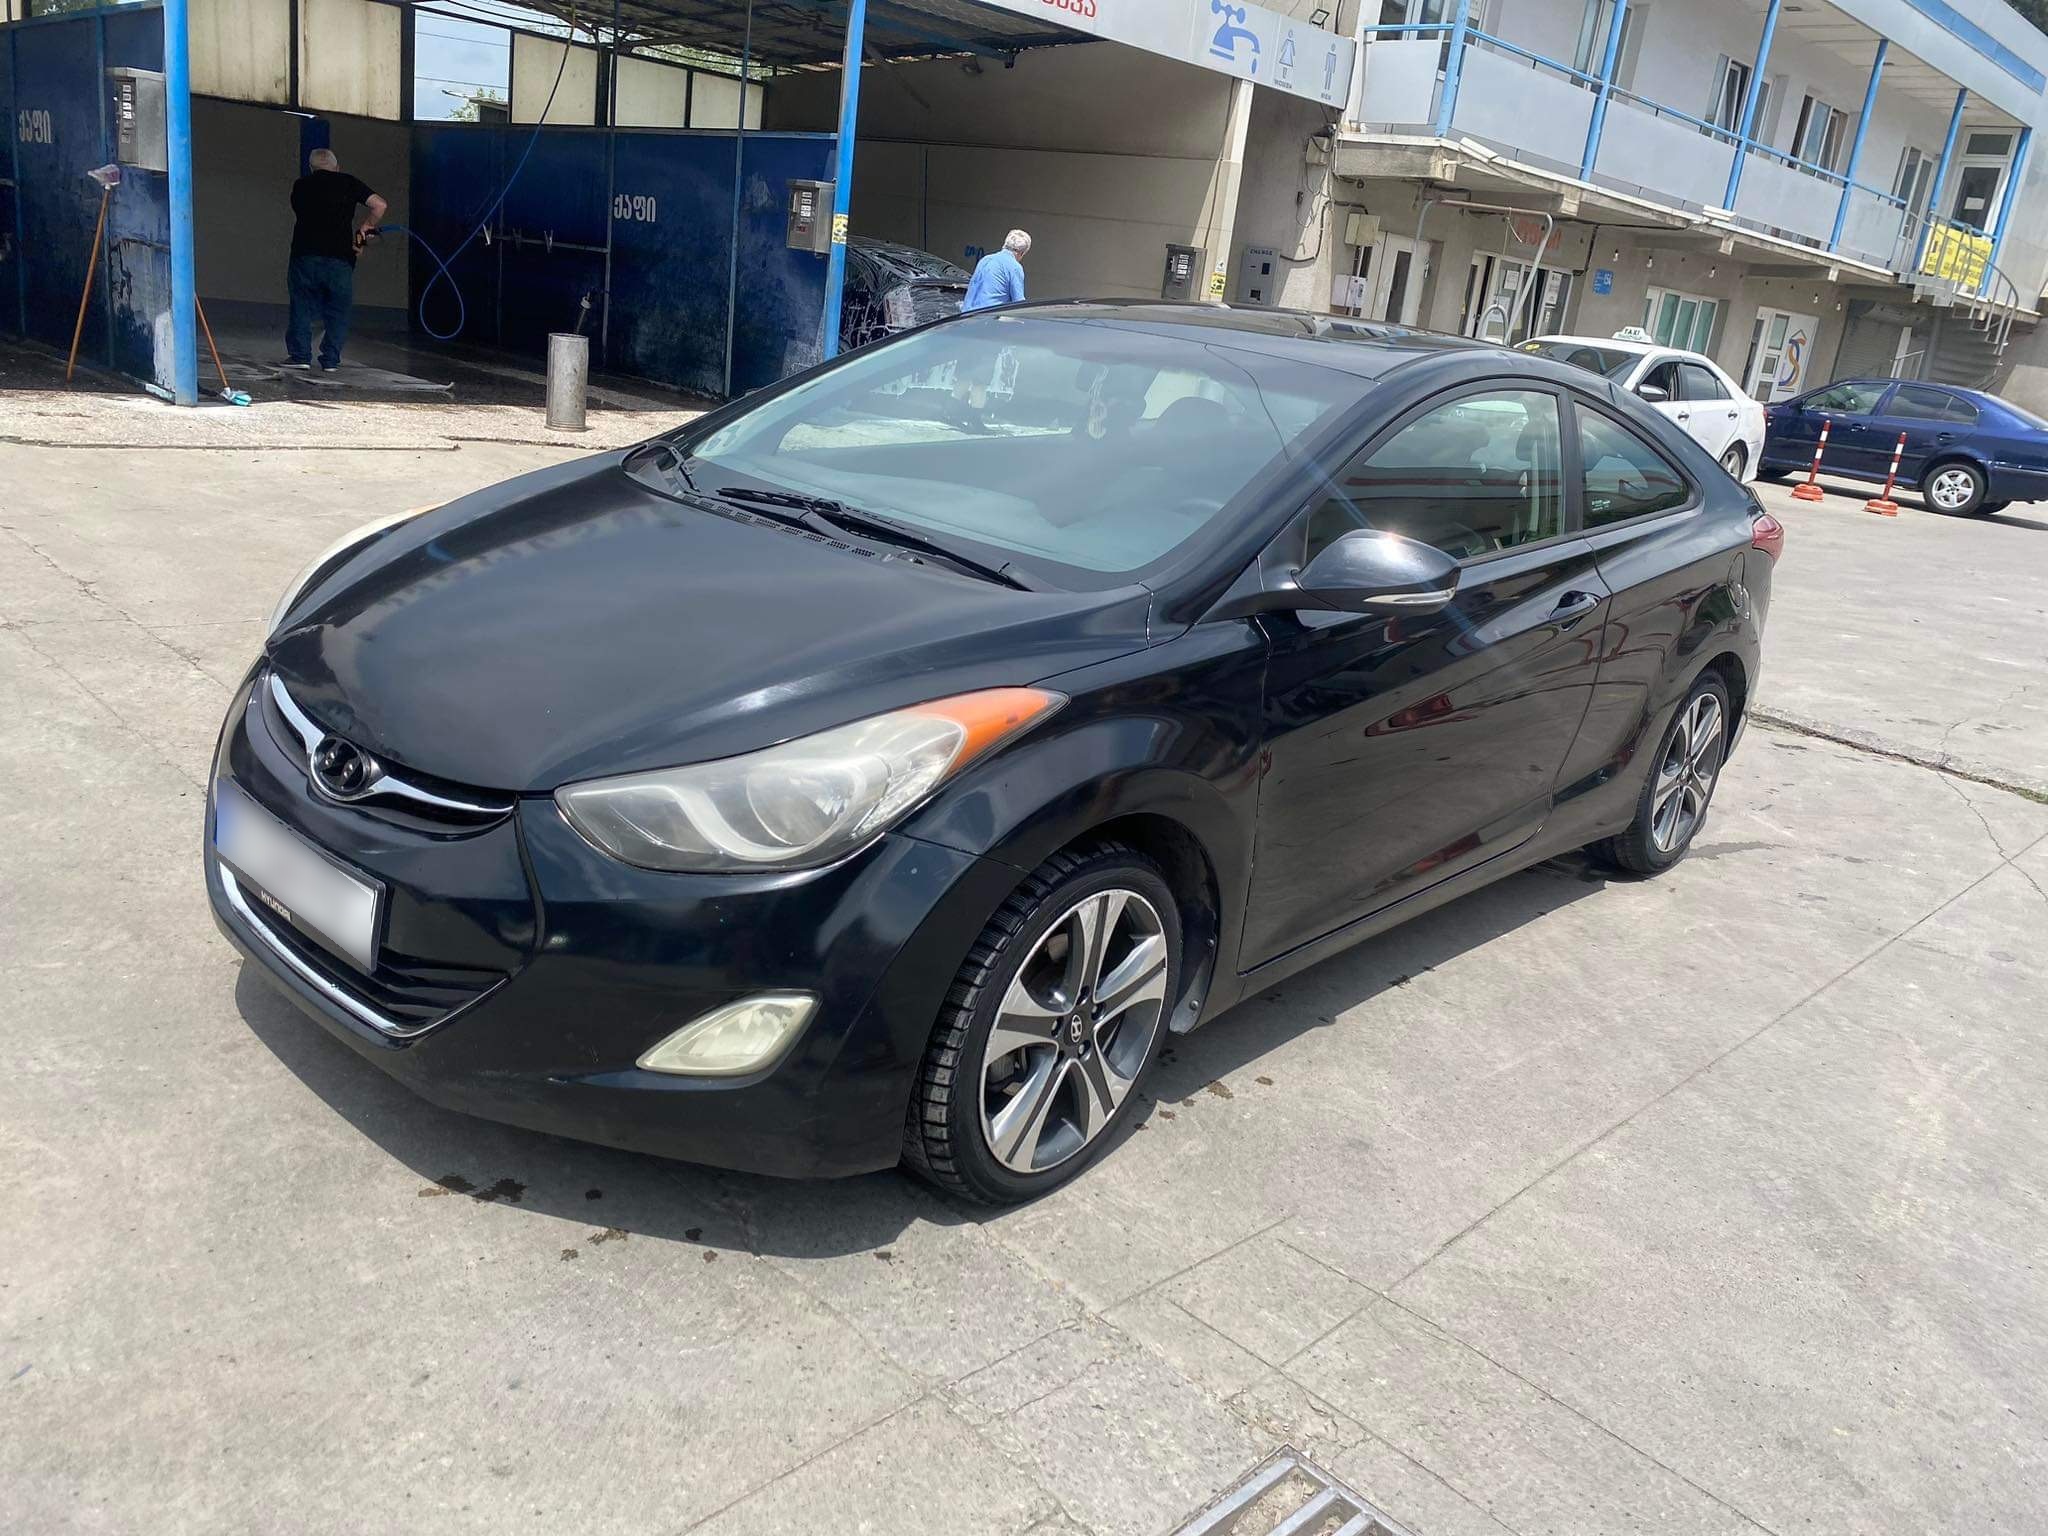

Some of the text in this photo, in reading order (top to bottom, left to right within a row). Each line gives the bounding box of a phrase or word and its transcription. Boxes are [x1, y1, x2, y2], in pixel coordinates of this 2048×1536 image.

[18, 109, 52, 144] ქაფი
[613, 193, 657, 223] ქაფი
[1624, 328, 1641, 336] TAXI
